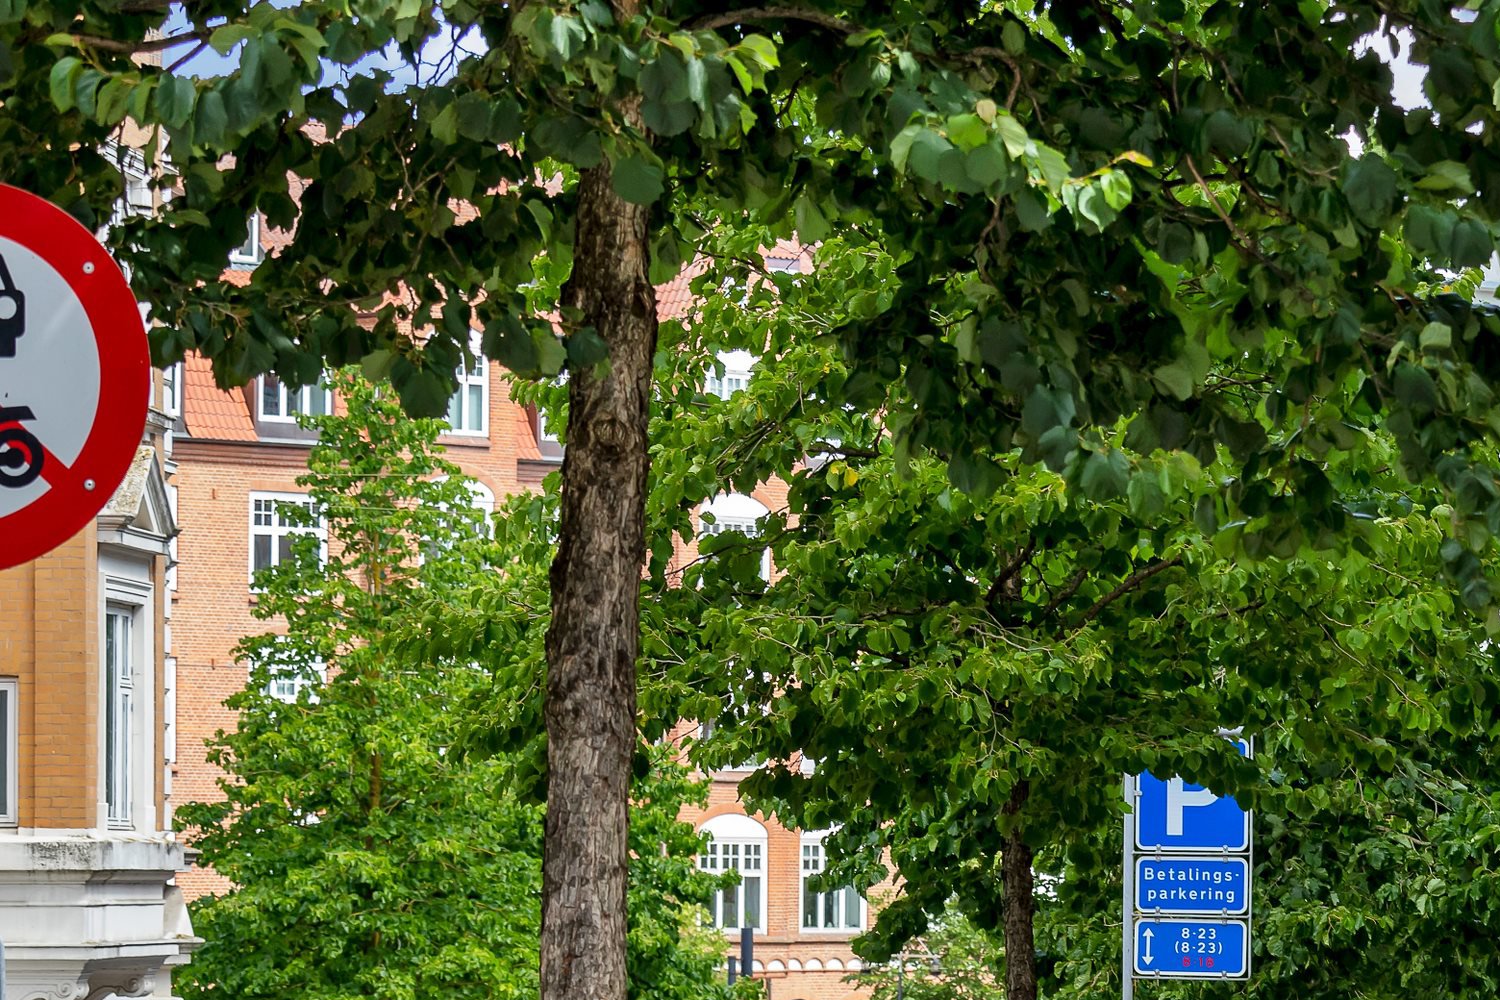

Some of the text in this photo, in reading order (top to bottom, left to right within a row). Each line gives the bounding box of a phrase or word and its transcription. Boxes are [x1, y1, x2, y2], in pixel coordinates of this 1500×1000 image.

[1144, 867, 1240, 884] Betalings-
[1147, 887, 1235, 903] parkering
[1181, 927, 1216, 939] 8-23
[1175, 940, 1222, 955] (8-23)
